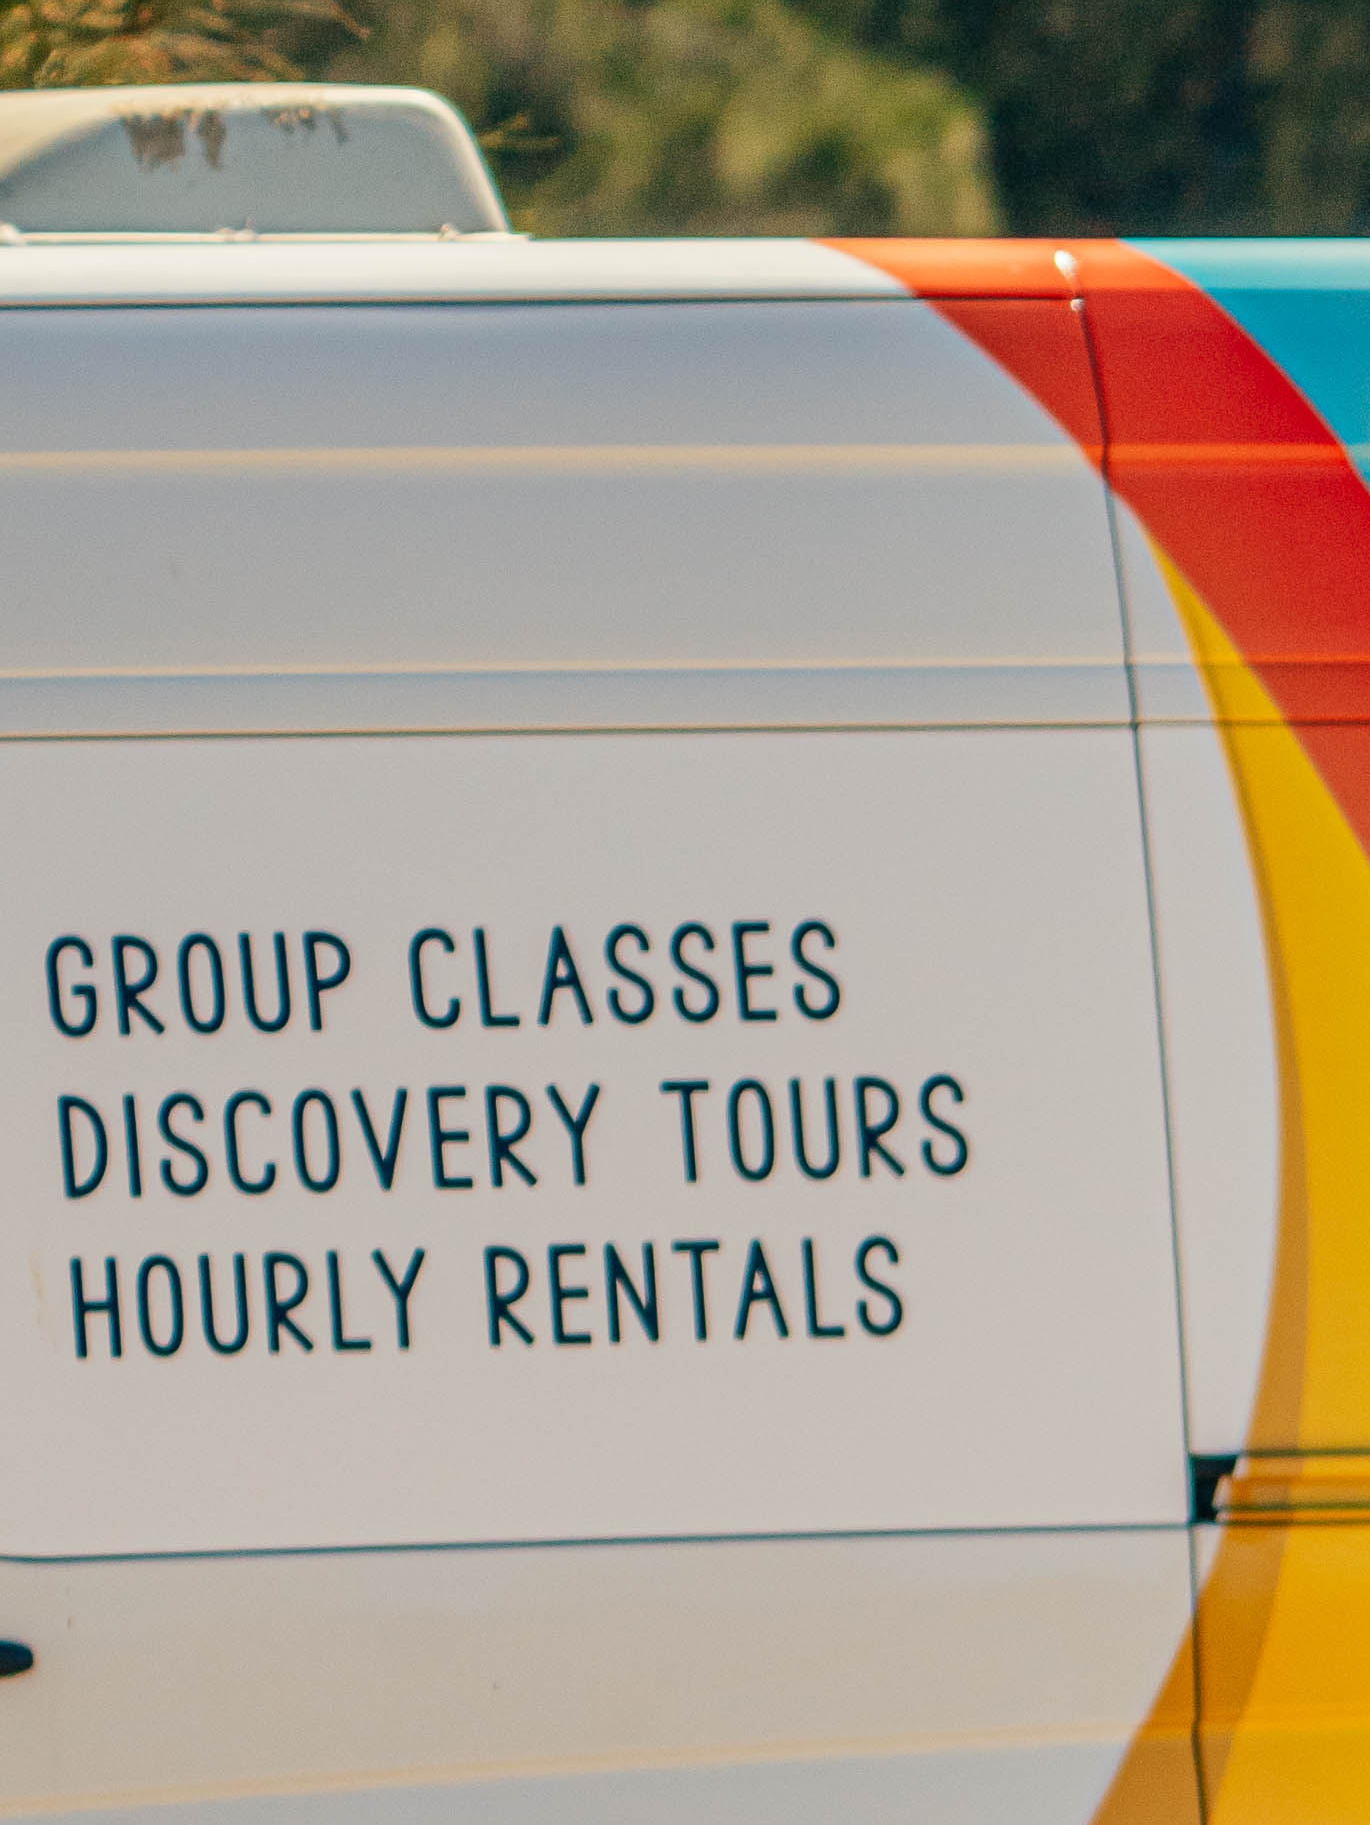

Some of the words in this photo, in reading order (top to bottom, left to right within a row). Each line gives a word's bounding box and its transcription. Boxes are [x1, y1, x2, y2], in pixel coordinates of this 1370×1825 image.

[45, 931, 351, 1037] GROUP
[408, 919, 842, 1029] CLASSES
[57, 1082, 601, 1200] DISCOVERY
[661, 1073, 970, 1184] TOURS
[68, 1246, 426, 1360] HOURLY
[482, 1234, 905, 1348] RENTALS
